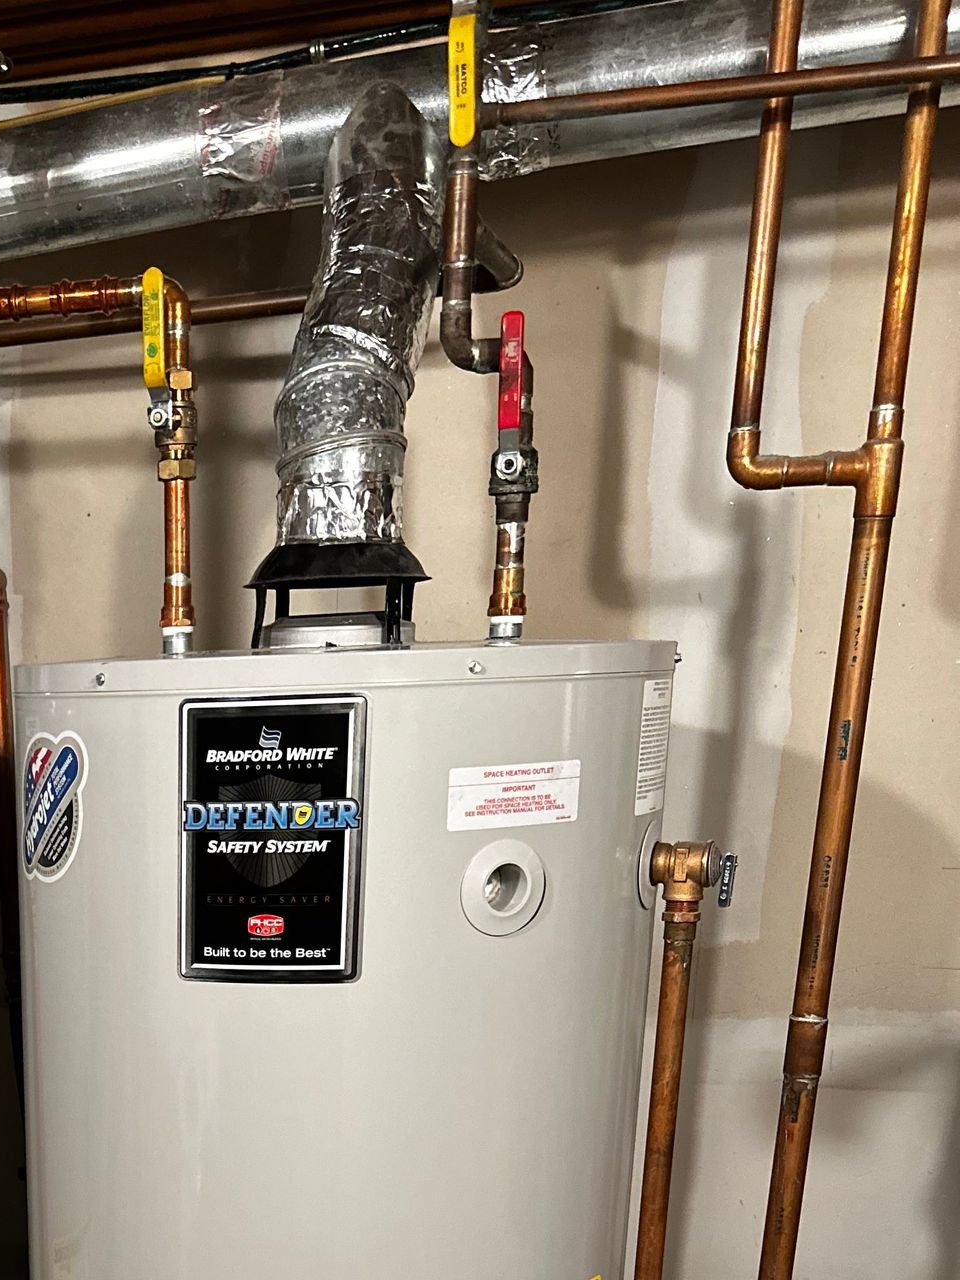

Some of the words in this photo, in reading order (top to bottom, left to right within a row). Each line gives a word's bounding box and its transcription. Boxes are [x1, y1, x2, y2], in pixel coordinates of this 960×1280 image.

[206, 749, 282, 762] BRADFORD
[286, 748, 334, 760] WHITE
[502, 785, 536, 793] IMPORTANT
[26, 781, 54, 856] Hydrojet
[184, 800, 360, 830] DEFENDER
[208, 840, 263, 854] SAFETY
[265, 840, 327, 854] SYSTEM
[208, 896, 267, 904] ENERGY
[204, 946, 230, 957] Built
[233, 948, 246, 957] to
[250, 948, 267, 958] be
[270, 948, 291, 958] the
[296, 948, 326, 958] Best
